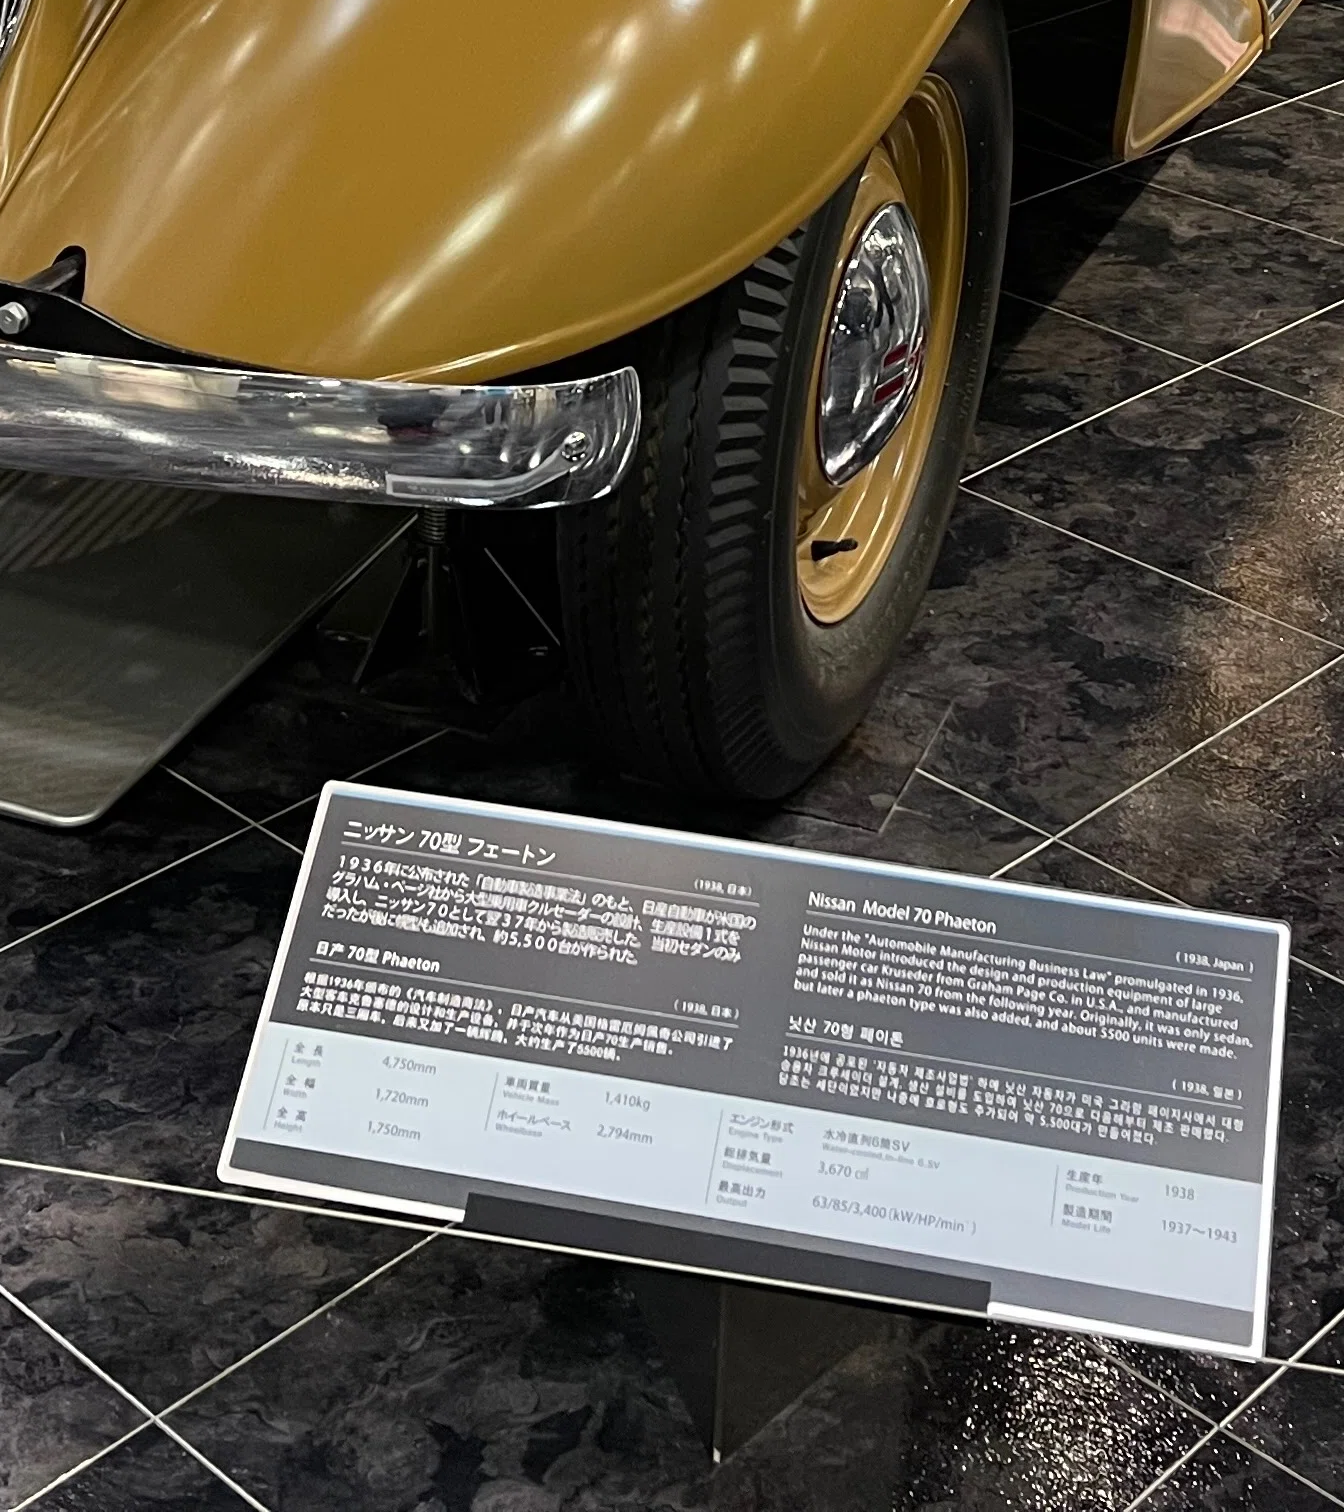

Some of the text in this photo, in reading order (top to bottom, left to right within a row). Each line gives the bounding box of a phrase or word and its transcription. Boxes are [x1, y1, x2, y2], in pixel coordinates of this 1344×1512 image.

[343, 821, 556, 866] ニッサン 70型 フェートン
[808, 891, 997, 934] Nissan Model 70 Phaeton
[316, 940, 440, 973] 日产 70型 Phaeton
[803, 924, 839, 940] Under
[841, 930, 861, 946] the
[939, 945, 1026, 972] Manufacturing
[1028, 958, 1080, 978] Business
[1114, 975, 1193, 995] promulgated
[1195, 985, 1208, 997] in
[1212, 987, 1244, 1004] 1936,
[798, 953, 858, 972] passenger
[860, 962, 879, 974] car
[881, 964, 933, 983] Kruseder
[936, 972, 965, 988] from
[967, 977, 1014, 995] Graham
[1016, 985, 1046, 1002] Page
[1048, 990, 1069, 1004] Co.
[1070, 993, 1083, 1007] in
[1126, 1005, 1151, 1017] and
[1152, 1009, 1238, 1030] manufactured
[800, 937, 1223, 1016] Nissan Motor introduced the design and production equipment of large
[793, 977, 1237, 1059] but later a phaeton type was also added, and about 5500 units were made.
[795, 966, 1253, 1048] and sold it as Nissan 70 from the following year. Originally, it was only sedan,
[382, 1056, 437, 1075] 4,750mm
[376, 1088, 429, 1107] 1,720mm
[605, 1091, 651, 1112] 1,410kg
[368, 1120, 421, 1140] 1,750mm
[597, 1124, 653, 1144] 2,794mm
[818, 1160, 852, 1178] 3,670
[1165, 1184, 1195, 1201] 1938
